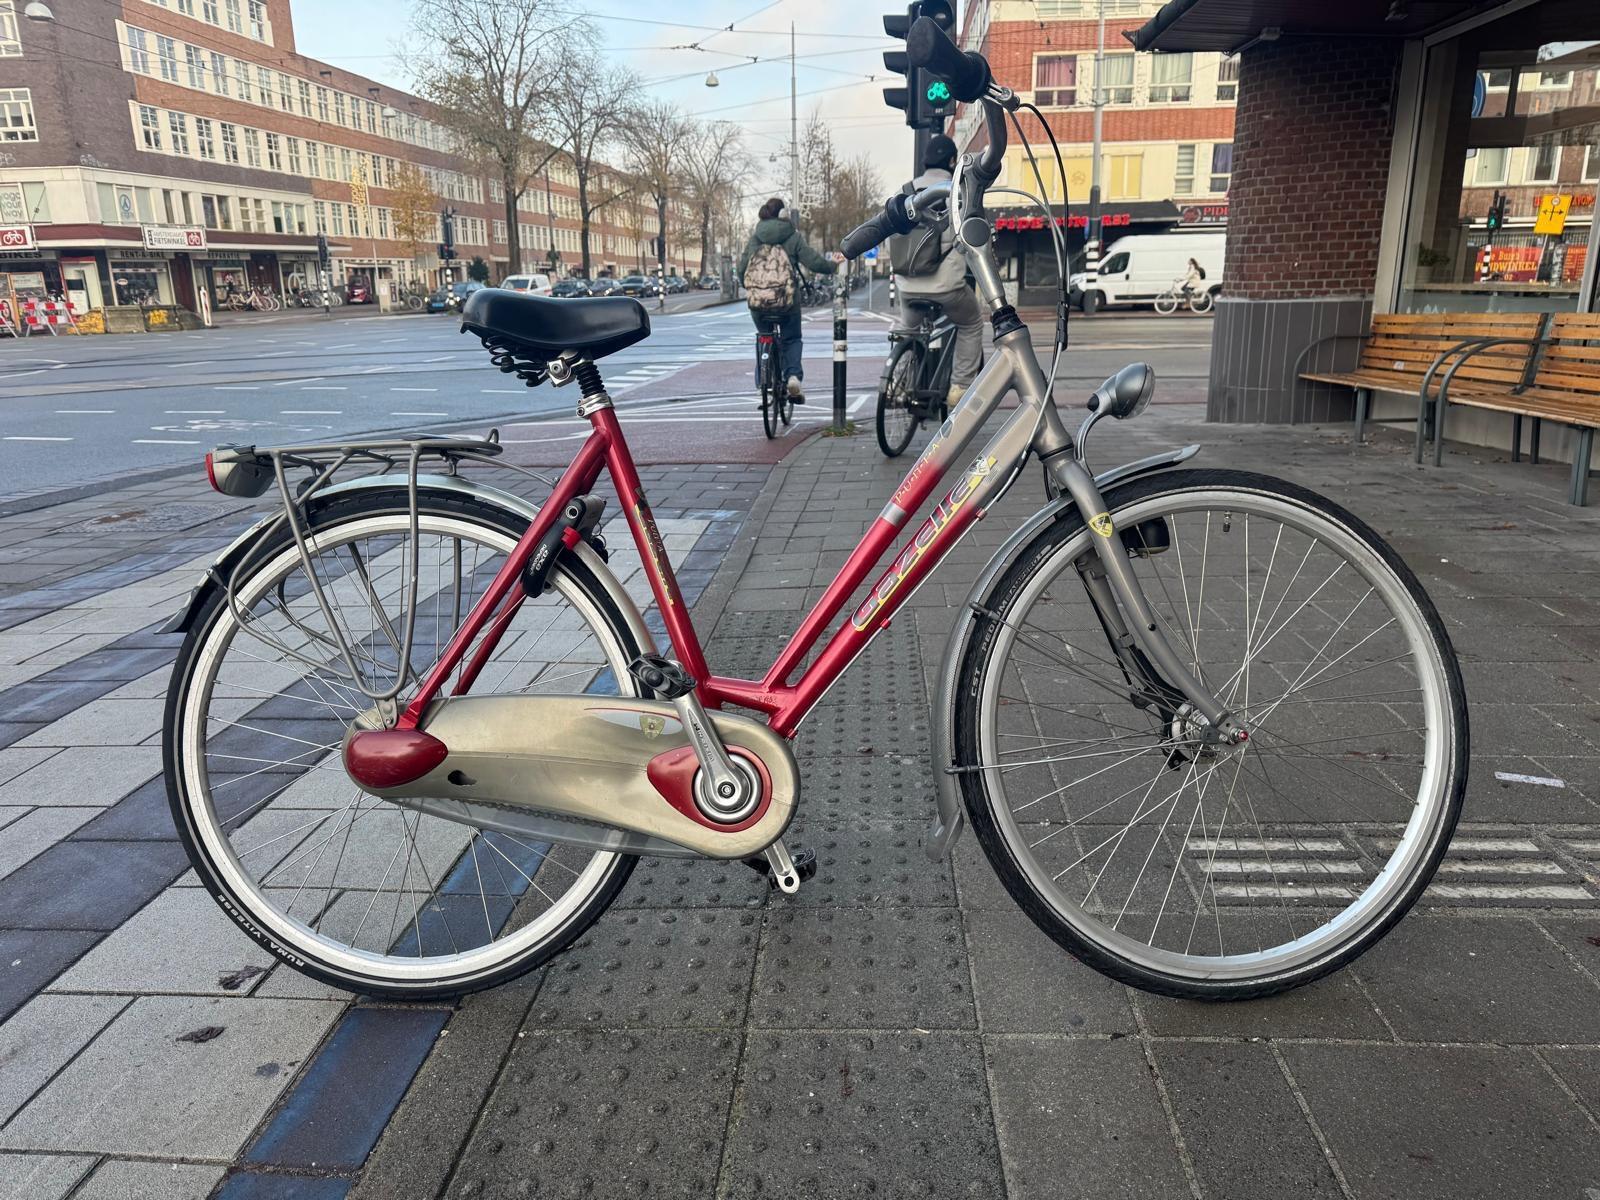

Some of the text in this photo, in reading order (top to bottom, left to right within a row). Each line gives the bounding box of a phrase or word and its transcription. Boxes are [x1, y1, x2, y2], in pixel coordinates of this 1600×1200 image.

[995, 216, 1043, 230] PIDE
[0, 251, 42, 259] BIKES
[120, 250, 166, 259] RENT-A-BIKE
[970, 667, 981, 697] CST
[217, 895, 305, 967] RUMA VITESSE
